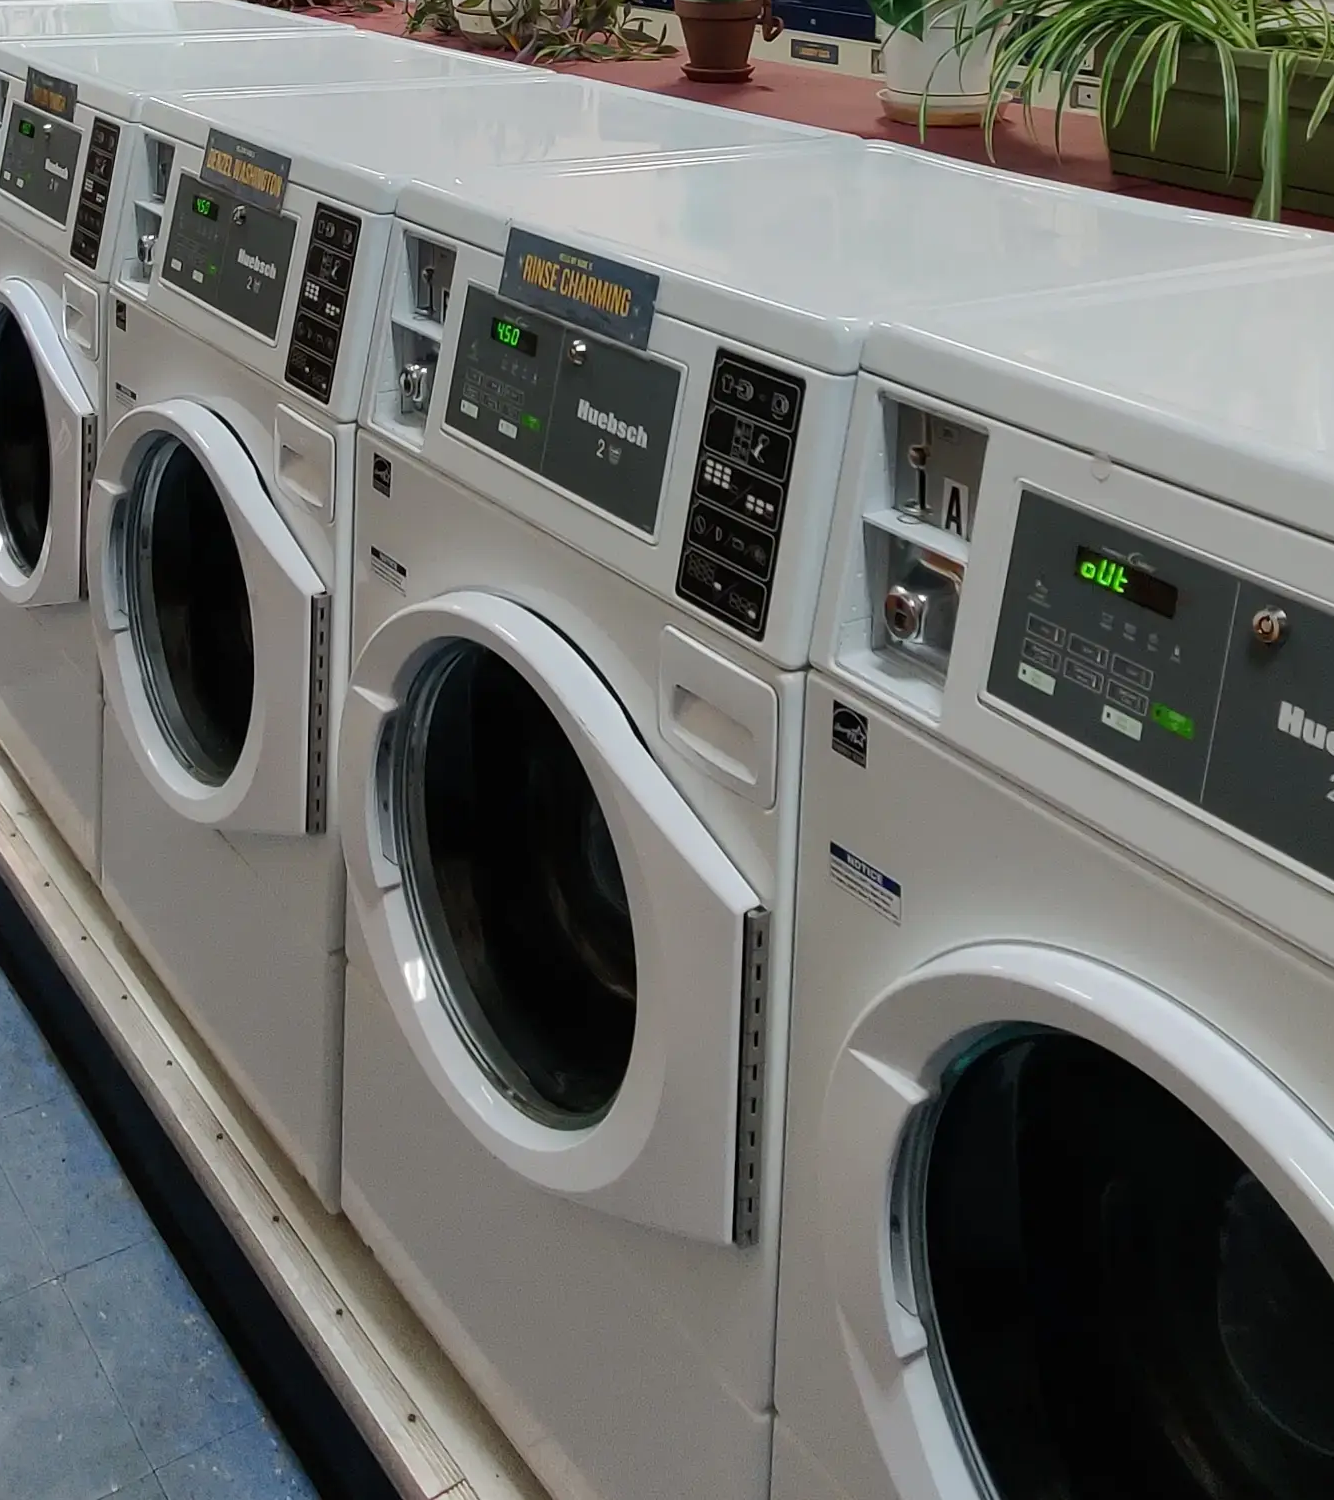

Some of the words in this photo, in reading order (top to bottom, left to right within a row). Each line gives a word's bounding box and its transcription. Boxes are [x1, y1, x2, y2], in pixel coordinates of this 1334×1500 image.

[522, 253, 560, 292] RINSE
[560, 268, 632, 317] CHARMING
[576, 398, 649, 449] Huebsch
[595, 439, 606, 459] 2
[945, 486, 963, 537] A
[846, 852, 885, 888] NOTICE
